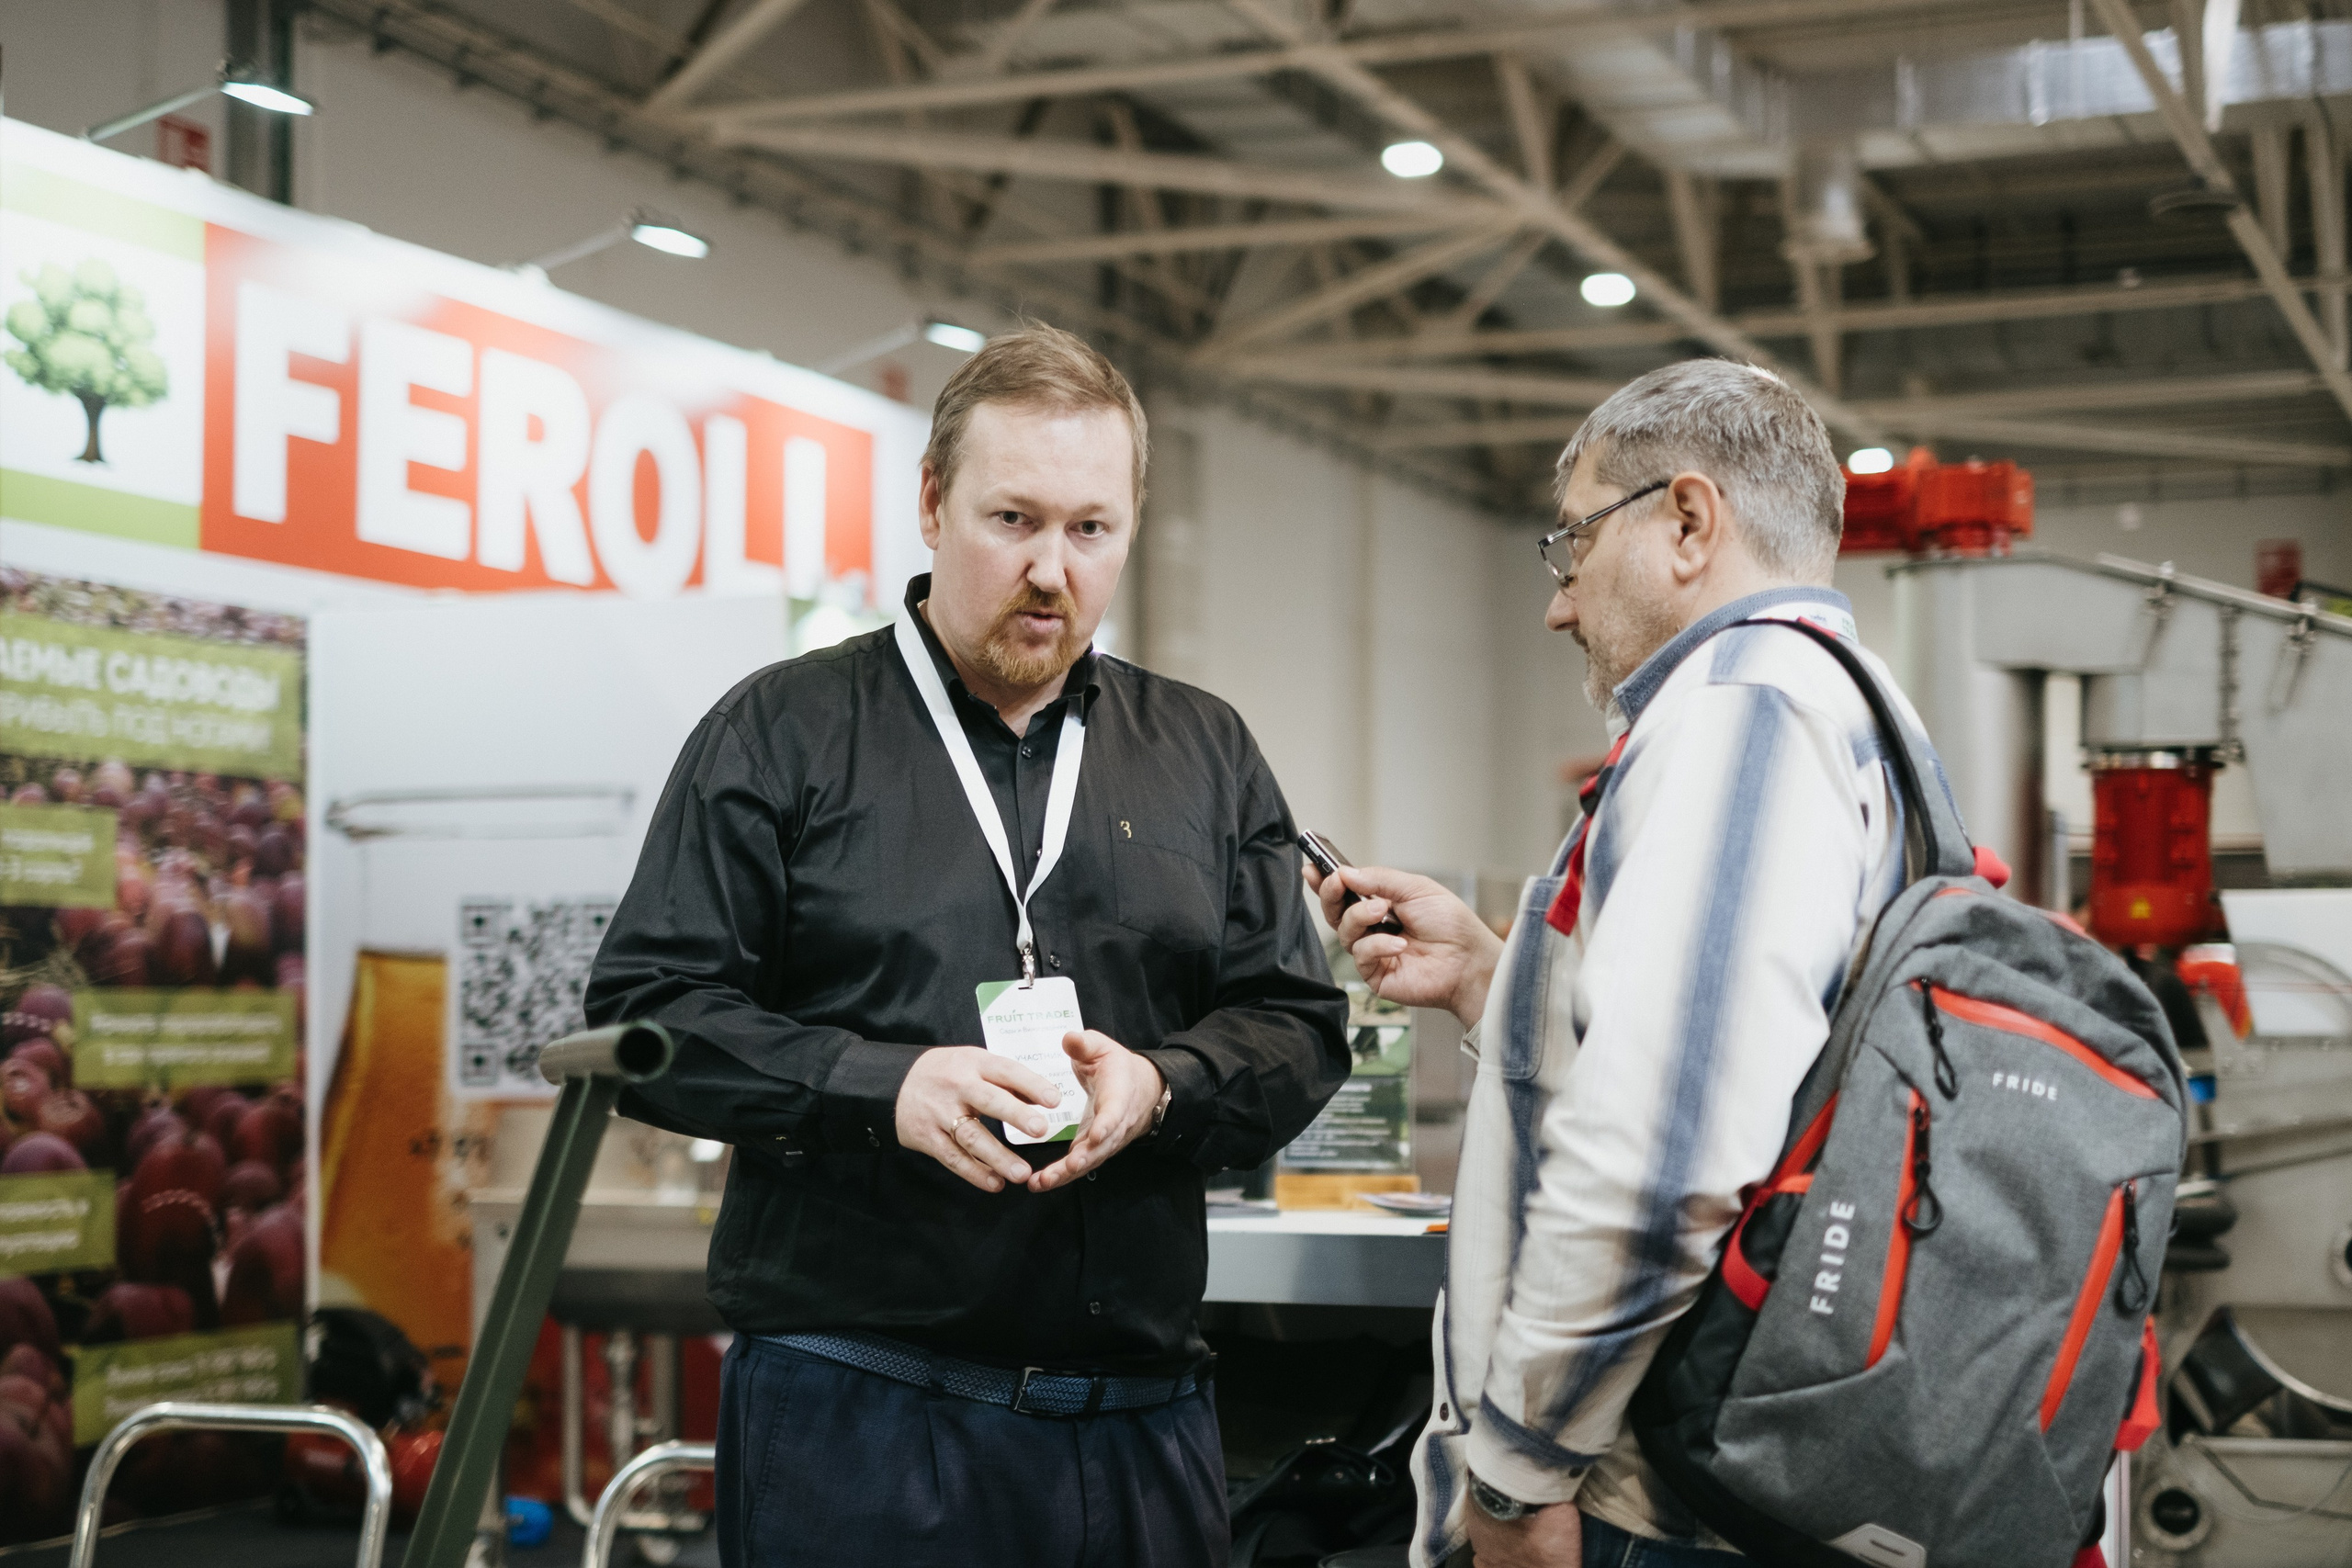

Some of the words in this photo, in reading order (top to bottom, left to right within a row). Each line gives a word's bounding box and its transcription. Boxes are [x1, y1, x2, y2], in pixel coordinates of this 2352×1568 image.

[232, 279, 827, 601] FEROLI
[1993, 1072, 2059, 1101] FRIDE
[1809, 1201, 1855, 1316] FRIDE
